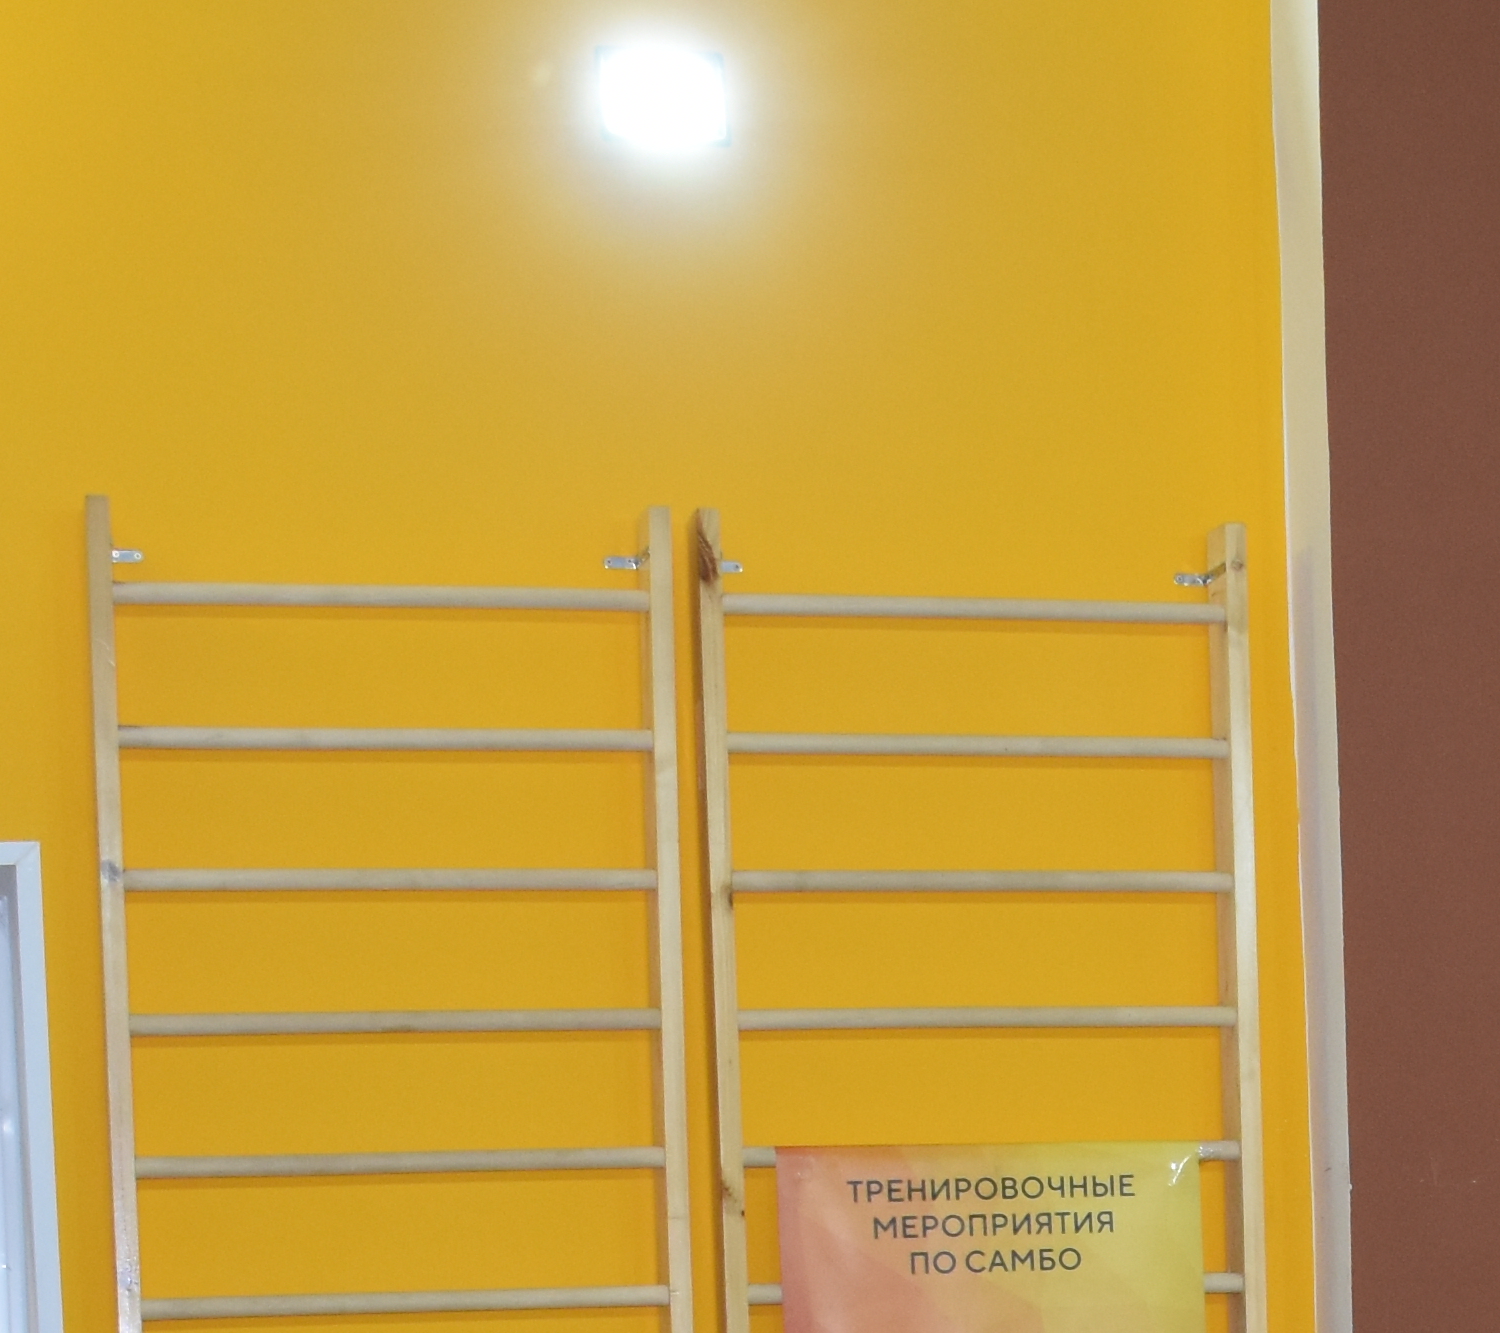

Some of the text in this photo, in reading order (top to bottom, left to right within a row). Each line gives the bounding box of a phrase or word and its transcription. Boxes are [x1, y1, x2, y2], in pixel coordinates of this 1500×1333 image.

[846, 1174, 1136, 1203] ТРЕНИРОВОЧНЫЕ
[873, 1210, 1115, 1240] МЕРОПРИЯТИЯ
[910, 1247, 1082, 1275] ПО САМБО
